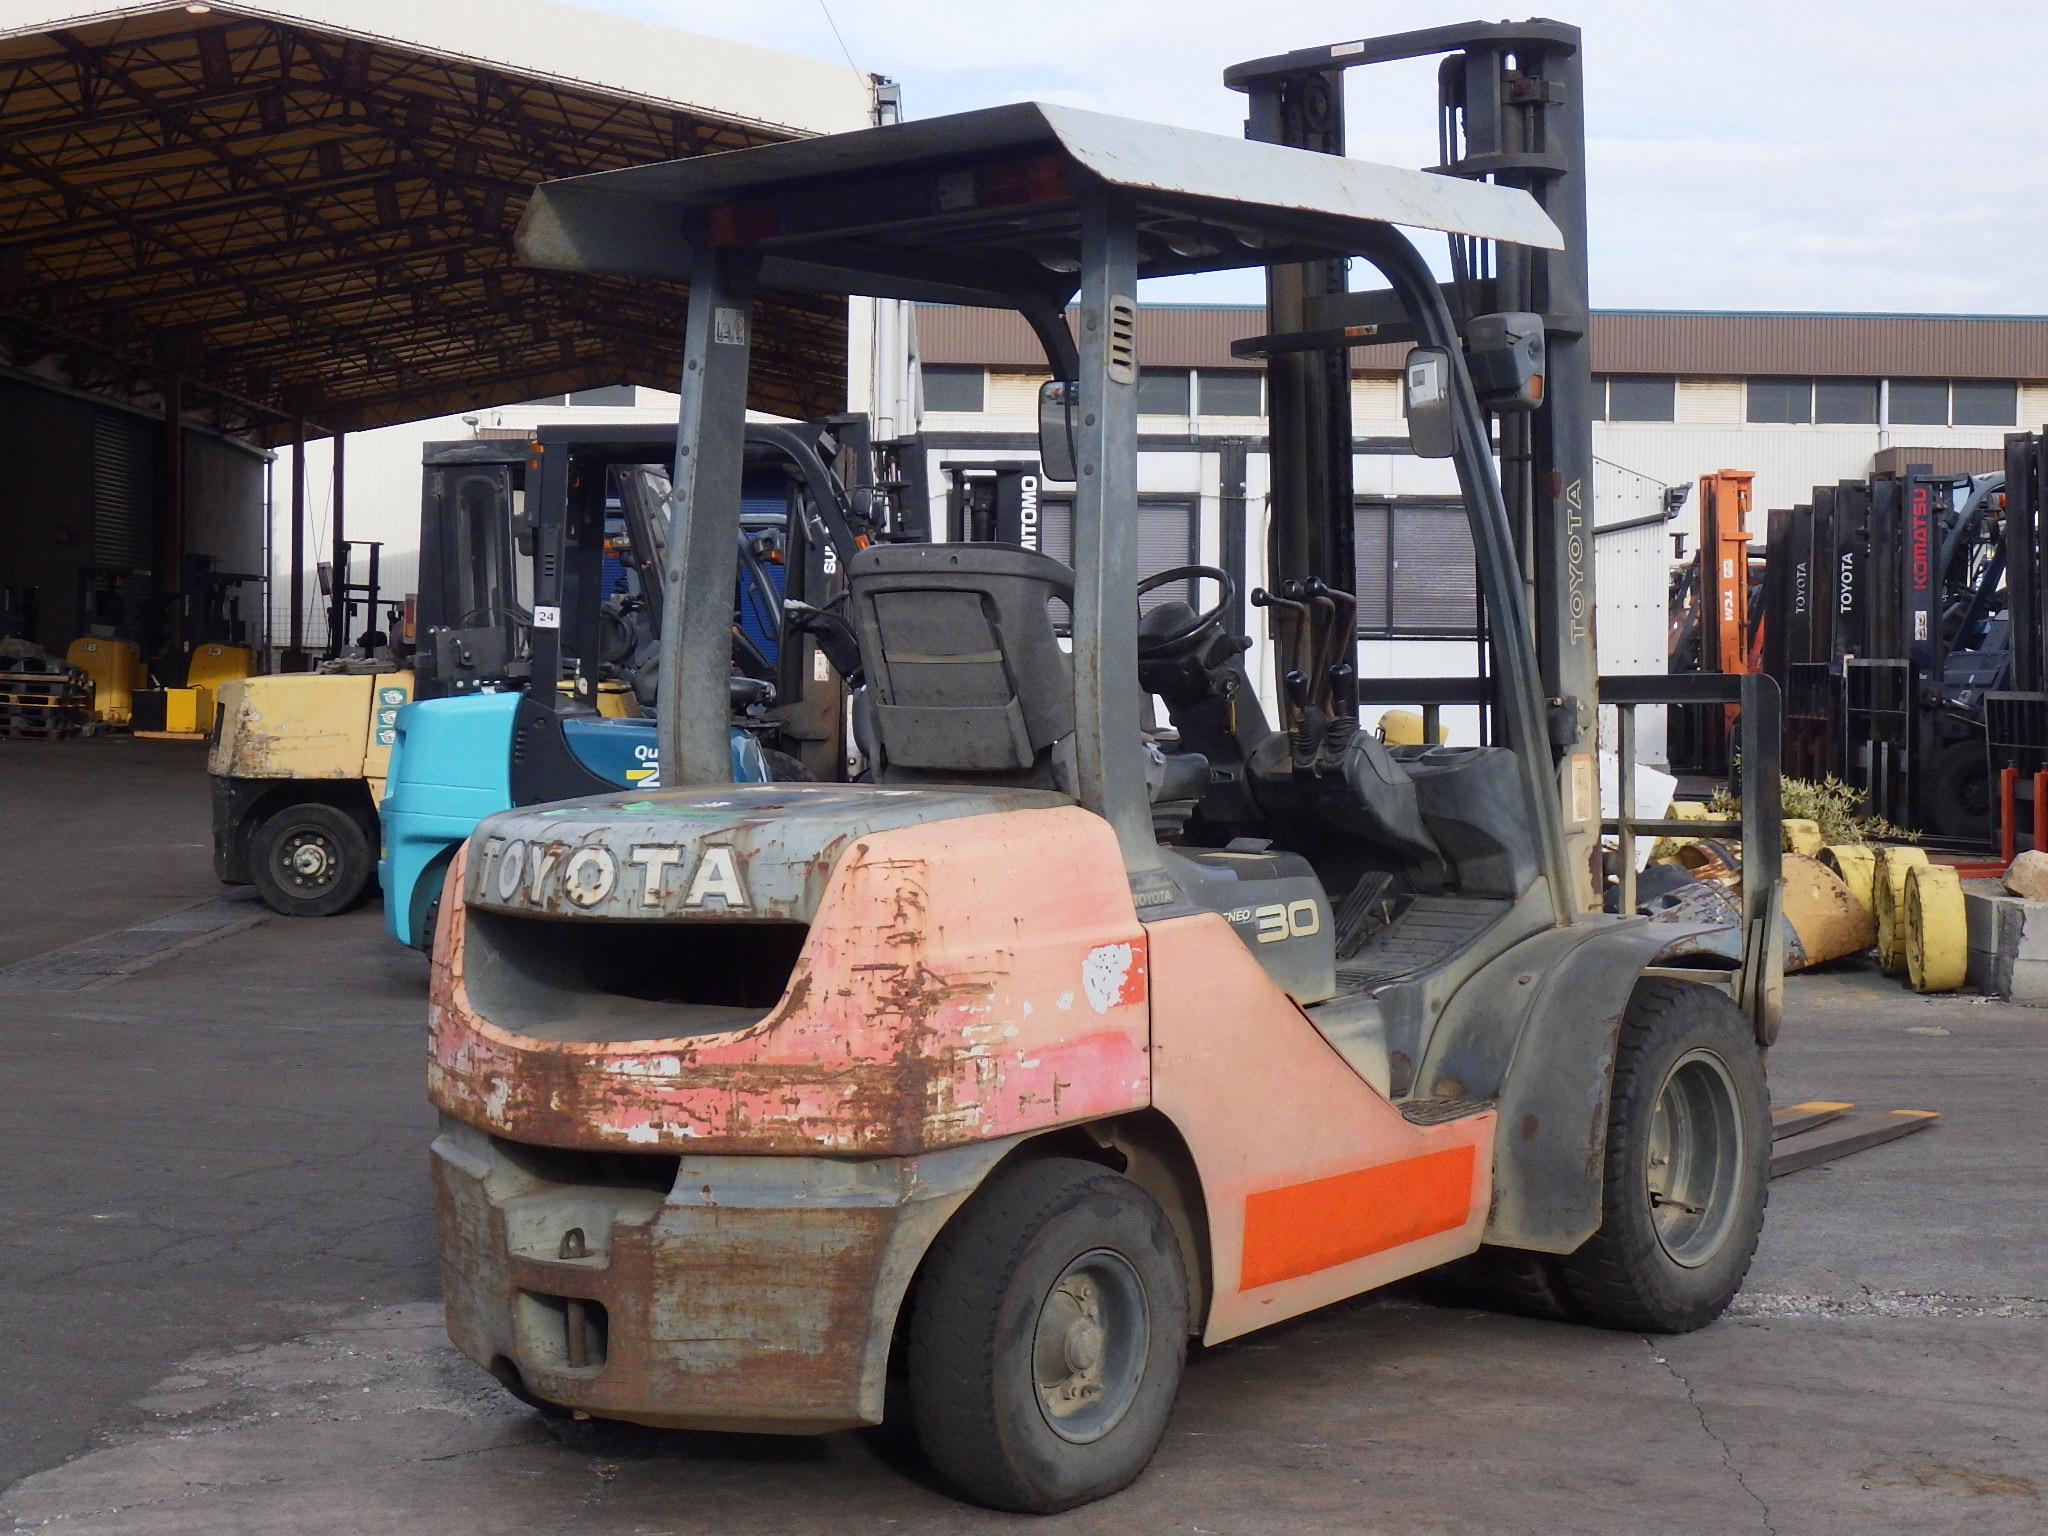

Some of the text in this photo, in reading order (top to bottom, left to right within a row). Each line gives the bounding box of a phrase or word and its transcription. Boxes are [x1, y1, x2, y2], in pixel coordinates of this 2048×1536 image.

[1566, 478, 1585, 645] TOYOTA
[1912, 488, 1929, 590] KOMATSU
[1724, 590, 1734, 621] TCM
[1795, 562, 1807, 614] TOYOTA
[1840, 552, 1853, 614] TOYOTA
[539, 611, 554, 622] 24
[479, 836, 749, 907] TOYOTA
[1133, 889, 1173, 907] TOYOTA
[1255, 898, 1320, 944] 30
